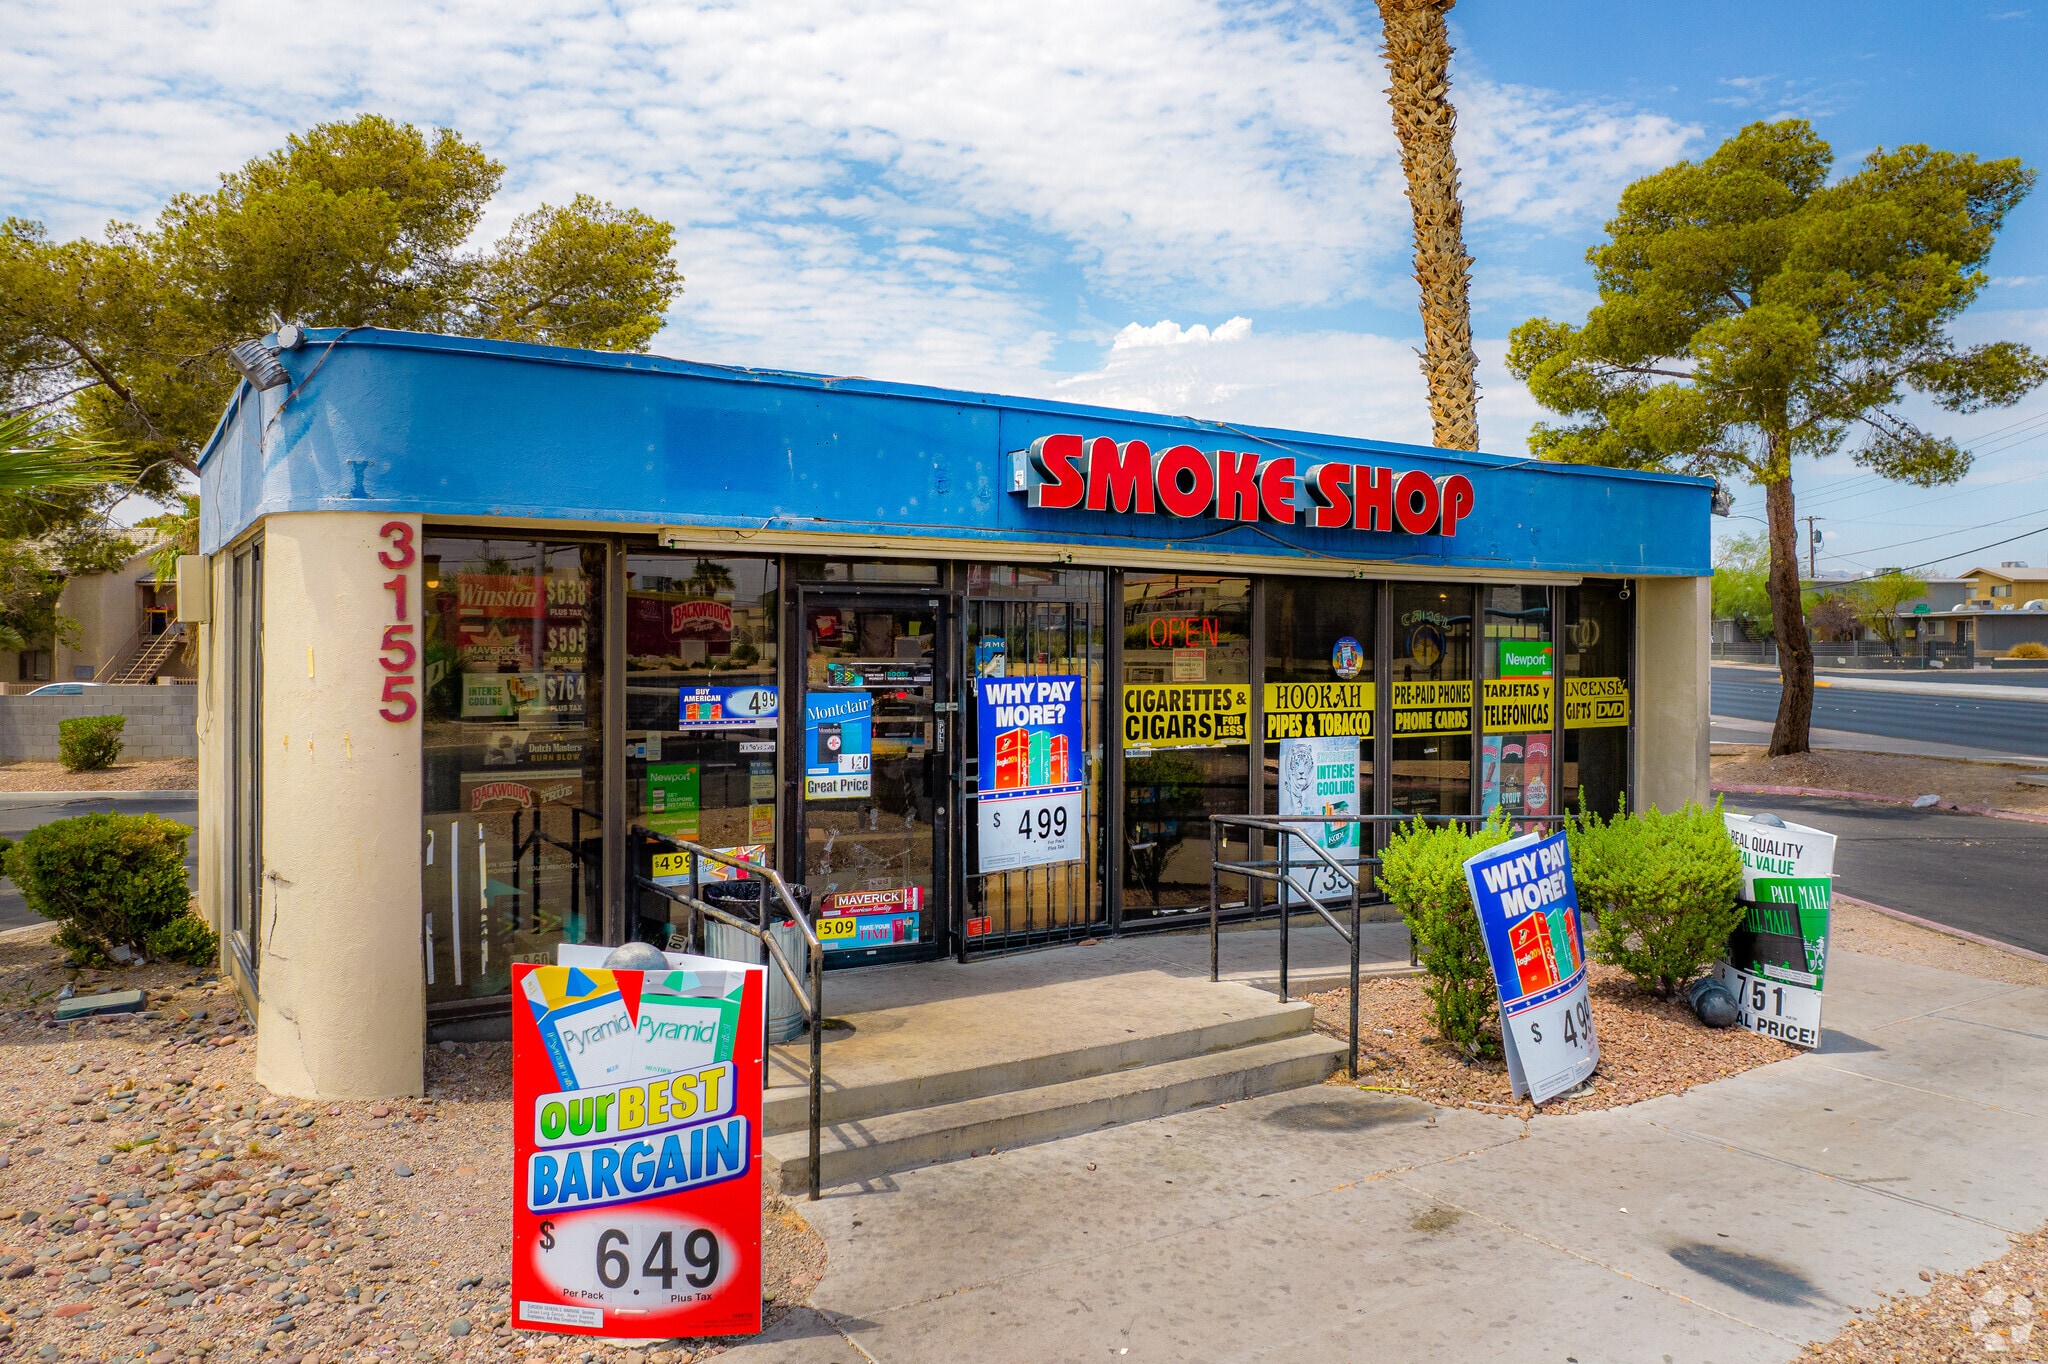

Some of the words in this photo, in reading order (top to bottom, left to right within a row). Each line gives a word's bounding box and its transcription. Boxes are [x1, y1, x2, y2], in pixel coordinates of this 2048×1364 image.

[1031, 434, 1295, 524] SMOKE
[1306, 462, 1475, 537] SHOP
[460, 583, 538, 607] Winston
[378, 521, 417, 723] 3155
[550, 608, 568, 616] PLUS
[672, 601, 732, 634] BACKWOODS
[1150, 617, 1219, 647] OPEN
[469, 646, 521, 655] MAVERICK
[569, 656, 583, 664] TAX
[1506, 652, 1546, 667] Newport
[469, 686, 502, 696] INTENSE
[696, 688, 710, 698] BUY
[985, 682, 1036, 705] WHY
[1038, 681, 1075, 702] PAY
[1275, 684, 1362, 710] HOOKAH
[1394, 683, 1436, 705] PRE-PAID
[1438, 684, 1471, 704] PHONES
[1484, 683, 1540, 698] TARJETAS
[1543, 686, 1550, 700] y
[1565, 681, 1624, 697] INCENSE
[469, 697, 502, 707] COOLING
[569, 704, 583, 712] TAX
[808, 698, 870, 721] Montclair
[1125, 688, 1232, 713] CIGARETTES
[1236, 691, 1247, 705] &
[1565, 701, 1592, 720] GIFTS
[1596, 703, 1624, 718] DVD
[996, 704, 1066, 728] MORE?
[1222, 715, 1241, 725] FOR
[1395, 711, 1432, 730] PHONE
[1435, 710, 1468, 729] CARDS
[1484, 699, 1549, 726] TELEFÓNICAS
[1125, 713, 1212, 740] CIGARS
[1217, 725, 1244, 737] LESS
[1267, 713, 1302, 739] PIPES
[1305, 713, 1316, 738] &
[1318, 711, 1371, 737] TOBACCO
[529, 743, 551, 753] Dutch
[553, 743, 582, 752] Masters
[556, 753, 580, 761] SLOW
[650, 773, 690, 783] Newport
[1316, 763, 1355, 780] INTENSE
[472, 782, 532, 811] BACKWOODS
[541, 785, 573, 804] TRUE
[808, 780, 837, 794] Great
[840, 779, 868, 791] Price
[1316, 780, 1355, 796] COOLING
[1502, 792, 1521, 804] STOUT
[993, 811, 1001, 829] $
[1731, 830, 1749, 850] REAL
[1752, 837, 1803, 859] QUALITY
[1481, 852, 1538, 894] WHY
[1539, 840, 1566, 875] PAY
[1738, 849, 1753, 868] EAL
[1755, 855, 1795, 876] VALUE
[838, 892, 900, 906] MAVERICK
[1500, 869, 1567, 919] MORE?
[1770, 885, 1797, 904] PALL
[1798, 885, 1829, 910] MALL
[1743, 908, 1763, 934] ALL
[1764, 909, 1795, 935] MALL
[860, 929, 889, 940] TIME
[1737, 974, 1783, 1017] 7.51
[563, 1011, 630, 1055] Pyramid
[637, 1015, 717, 1043] Pyramid
[1530, 1021, 1542, 1044] $
[1757, 1017, 1815, 1045] PRICE!
[541, 1091, 615, 1140] our
[618, 1066, 725, 1131] BEST
[533, 1119, 740, 1207] BARGAIN
[539, 1218, 555, 1253] $
[596, 1228, 720, 1296] 6.49
[563, 1288, 578, 1299] Per
[581, 1290, 604, 1300] Pack
[670, 1293, 692, 1303] Plus
[695, 1292, 712, 1302] Tax
